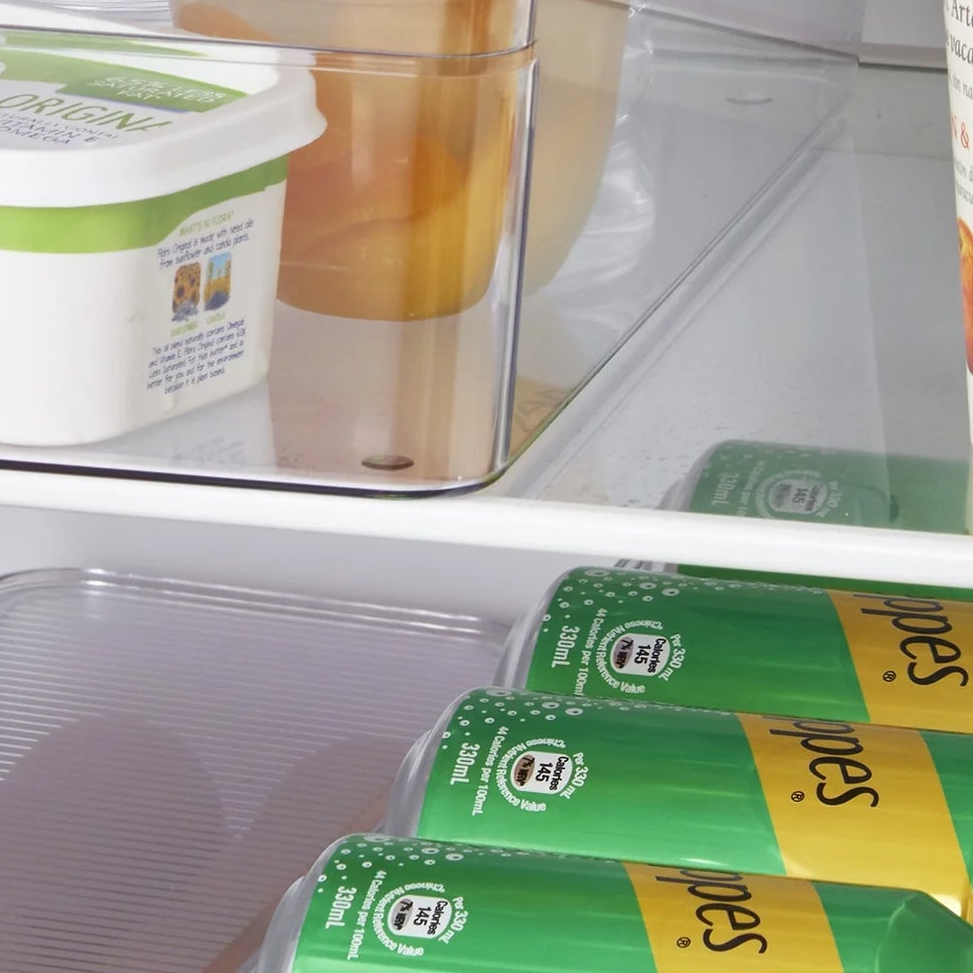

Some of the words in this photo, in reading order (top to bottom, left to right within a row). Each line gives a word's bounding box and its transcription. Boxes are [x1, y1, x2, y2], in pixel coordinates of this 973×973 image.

[596, 608, 608, 617] 44
[585, 618, 605, 649] Calories
[551, 625, 580, 668] 330mL
[633, 644, 651, 665] 145
[647, 638, 666, 673] Calories
[581, 650, 592, 665] per
[669, 648, 686, 669] 330
[620, 681, 645, 694] Value
[497, 726, 509, 735] 44
[485, 735, 505, 766] Calories
[450, 742, 480, 785] 330mL
[535, 762, 553, 783] 145
[549, 756, 569, 791] Calories
[480, 767, 492, 783] per
[571, 766, 589, 787] 330
[471, 785, 488, 816] 100mL
[520, 799, 547, 812] Value
[375, 870, 387, 879] 44
[361, 879, 383, 910] Calories
[325, 886, 357, 929] 330mL
[413, 906, 432, 927] 145
[427, 900, 448, 936] Calories
[356, 911, 368, 927] per
[451, 910, 469, 931] 330
[347, 928, 365, 960] 100mL
[397, 943, 425, 956] Value
